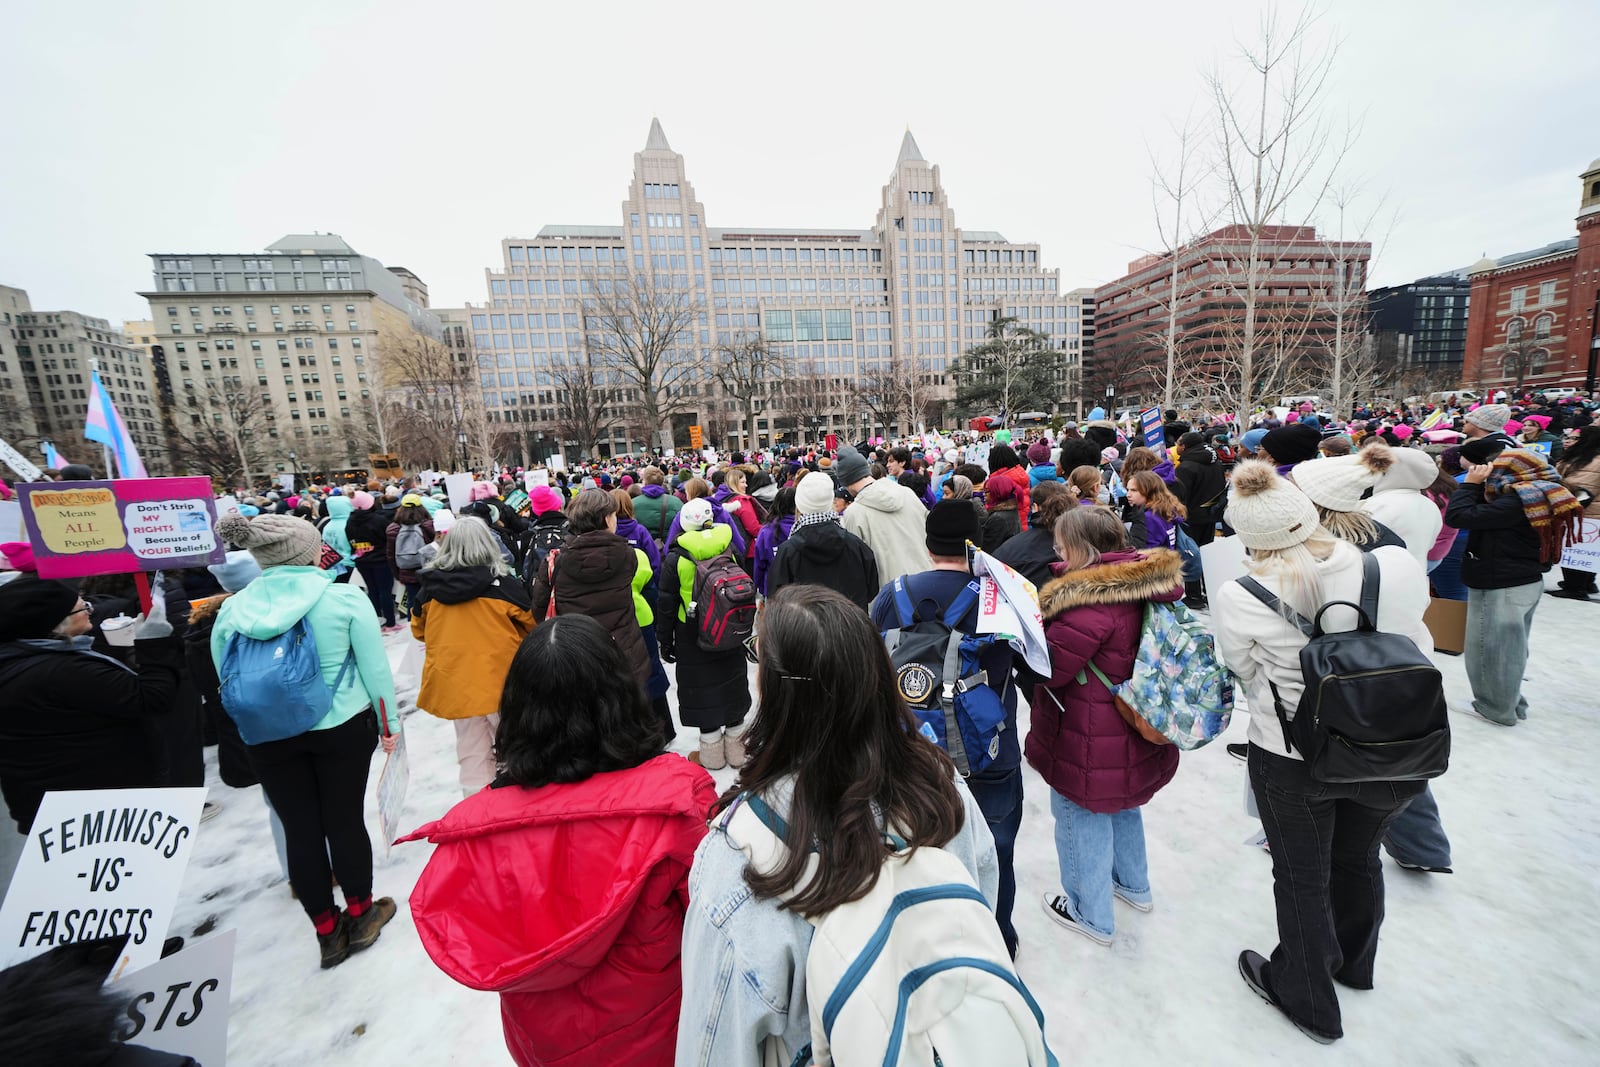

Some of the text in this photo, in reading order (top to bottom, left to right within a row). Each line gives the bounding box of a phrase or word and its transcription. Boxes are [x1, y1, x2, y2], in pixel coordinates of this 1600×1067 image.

[137, 503, 194, 512] Don't Strip
[59, 510, 97, 518] Means
[65, 522, 99, 534] ALL
[133, 525, 174, 534] RIGHTS
[64, 538, 105, 548] People!
[139, 544, 212, 556] YOUR Beliefs!
[1561, 555, 1593, 568] HERE
[38, 807, 190, 863] FEMINISTS
[77, 857, 133, 892] -VS-
[18, 908, 153, 947] FASCISTS
